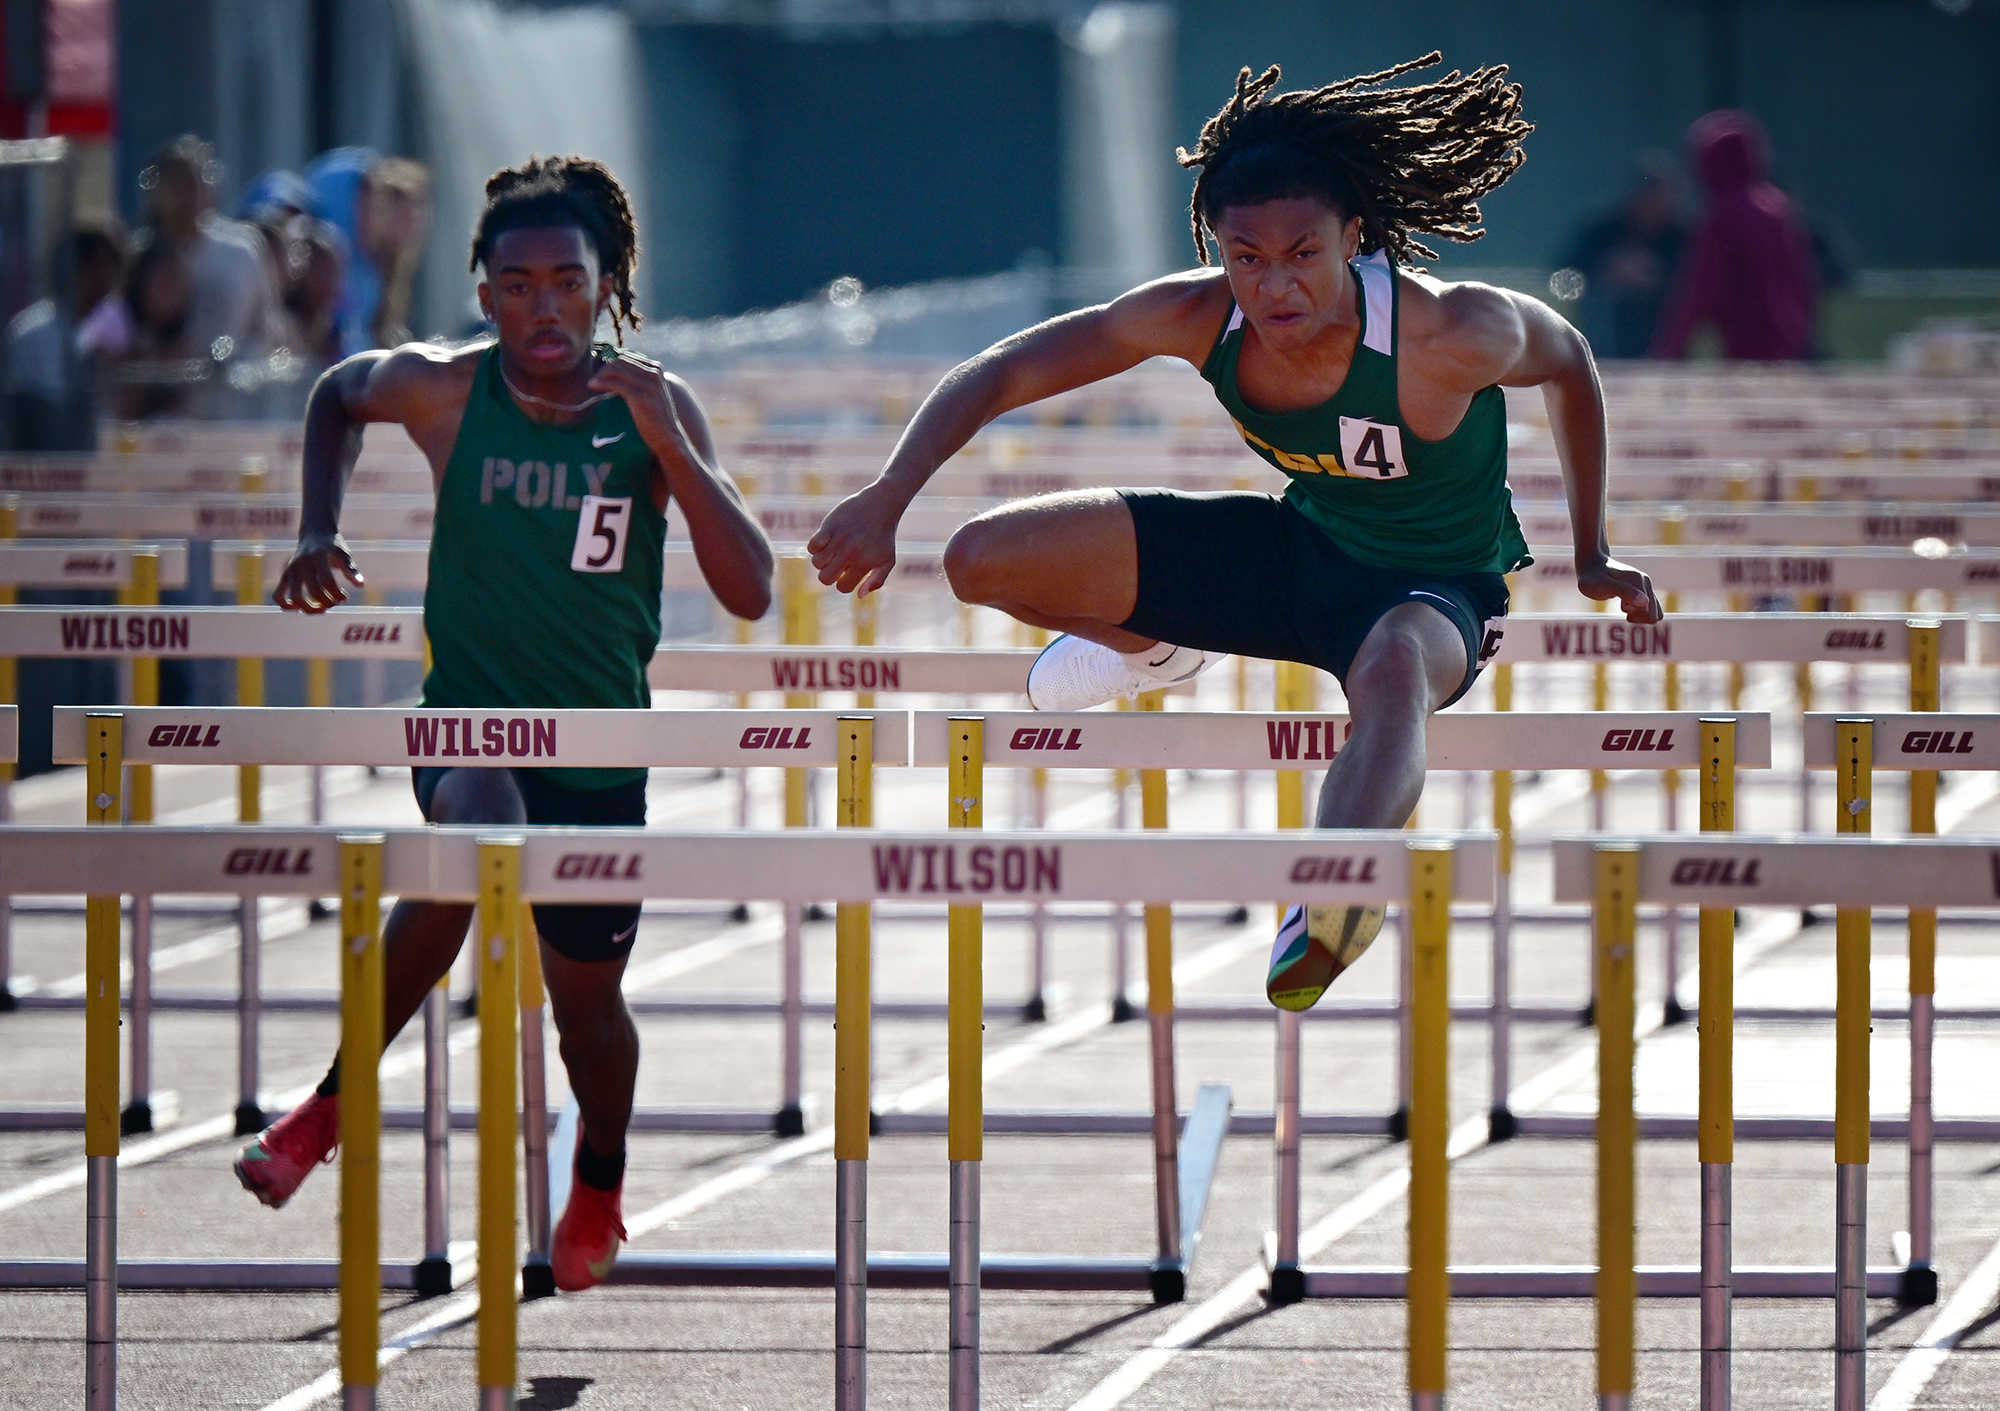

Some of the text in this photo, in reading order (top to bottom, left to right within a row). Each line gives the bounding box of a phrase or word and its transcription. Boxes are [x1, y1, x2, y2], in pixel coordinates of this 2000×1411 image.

[1353, 426, 1395, 477] 4
[480, 456, 613, 510] POLY
[586, 505, 622, 567] 5
[61, 617, 189, 650] WILSON
[342, 623, 401, 645] GILL
[1542, 623, 1671, 656] WILSON
[772, 659, 900, 690] WILSON
[148, 725, 221, 747] GILL
[404, 717, 556, 756] WILSON
[739, 728, 811, 749] GILL
[1010, 728, 1082, 750] GILL
[1602, 729, 1675, 751] GILL
[1901, 731, 1974, 753] GILL
[223, 849, 313, 876] GILL
[554, 853, 643, 880] GILL
[872, 845, 1062, 893] WILSON
[1289, 856, 1379, 885] GILL
[1671, 857, 1762, 887] GILL
